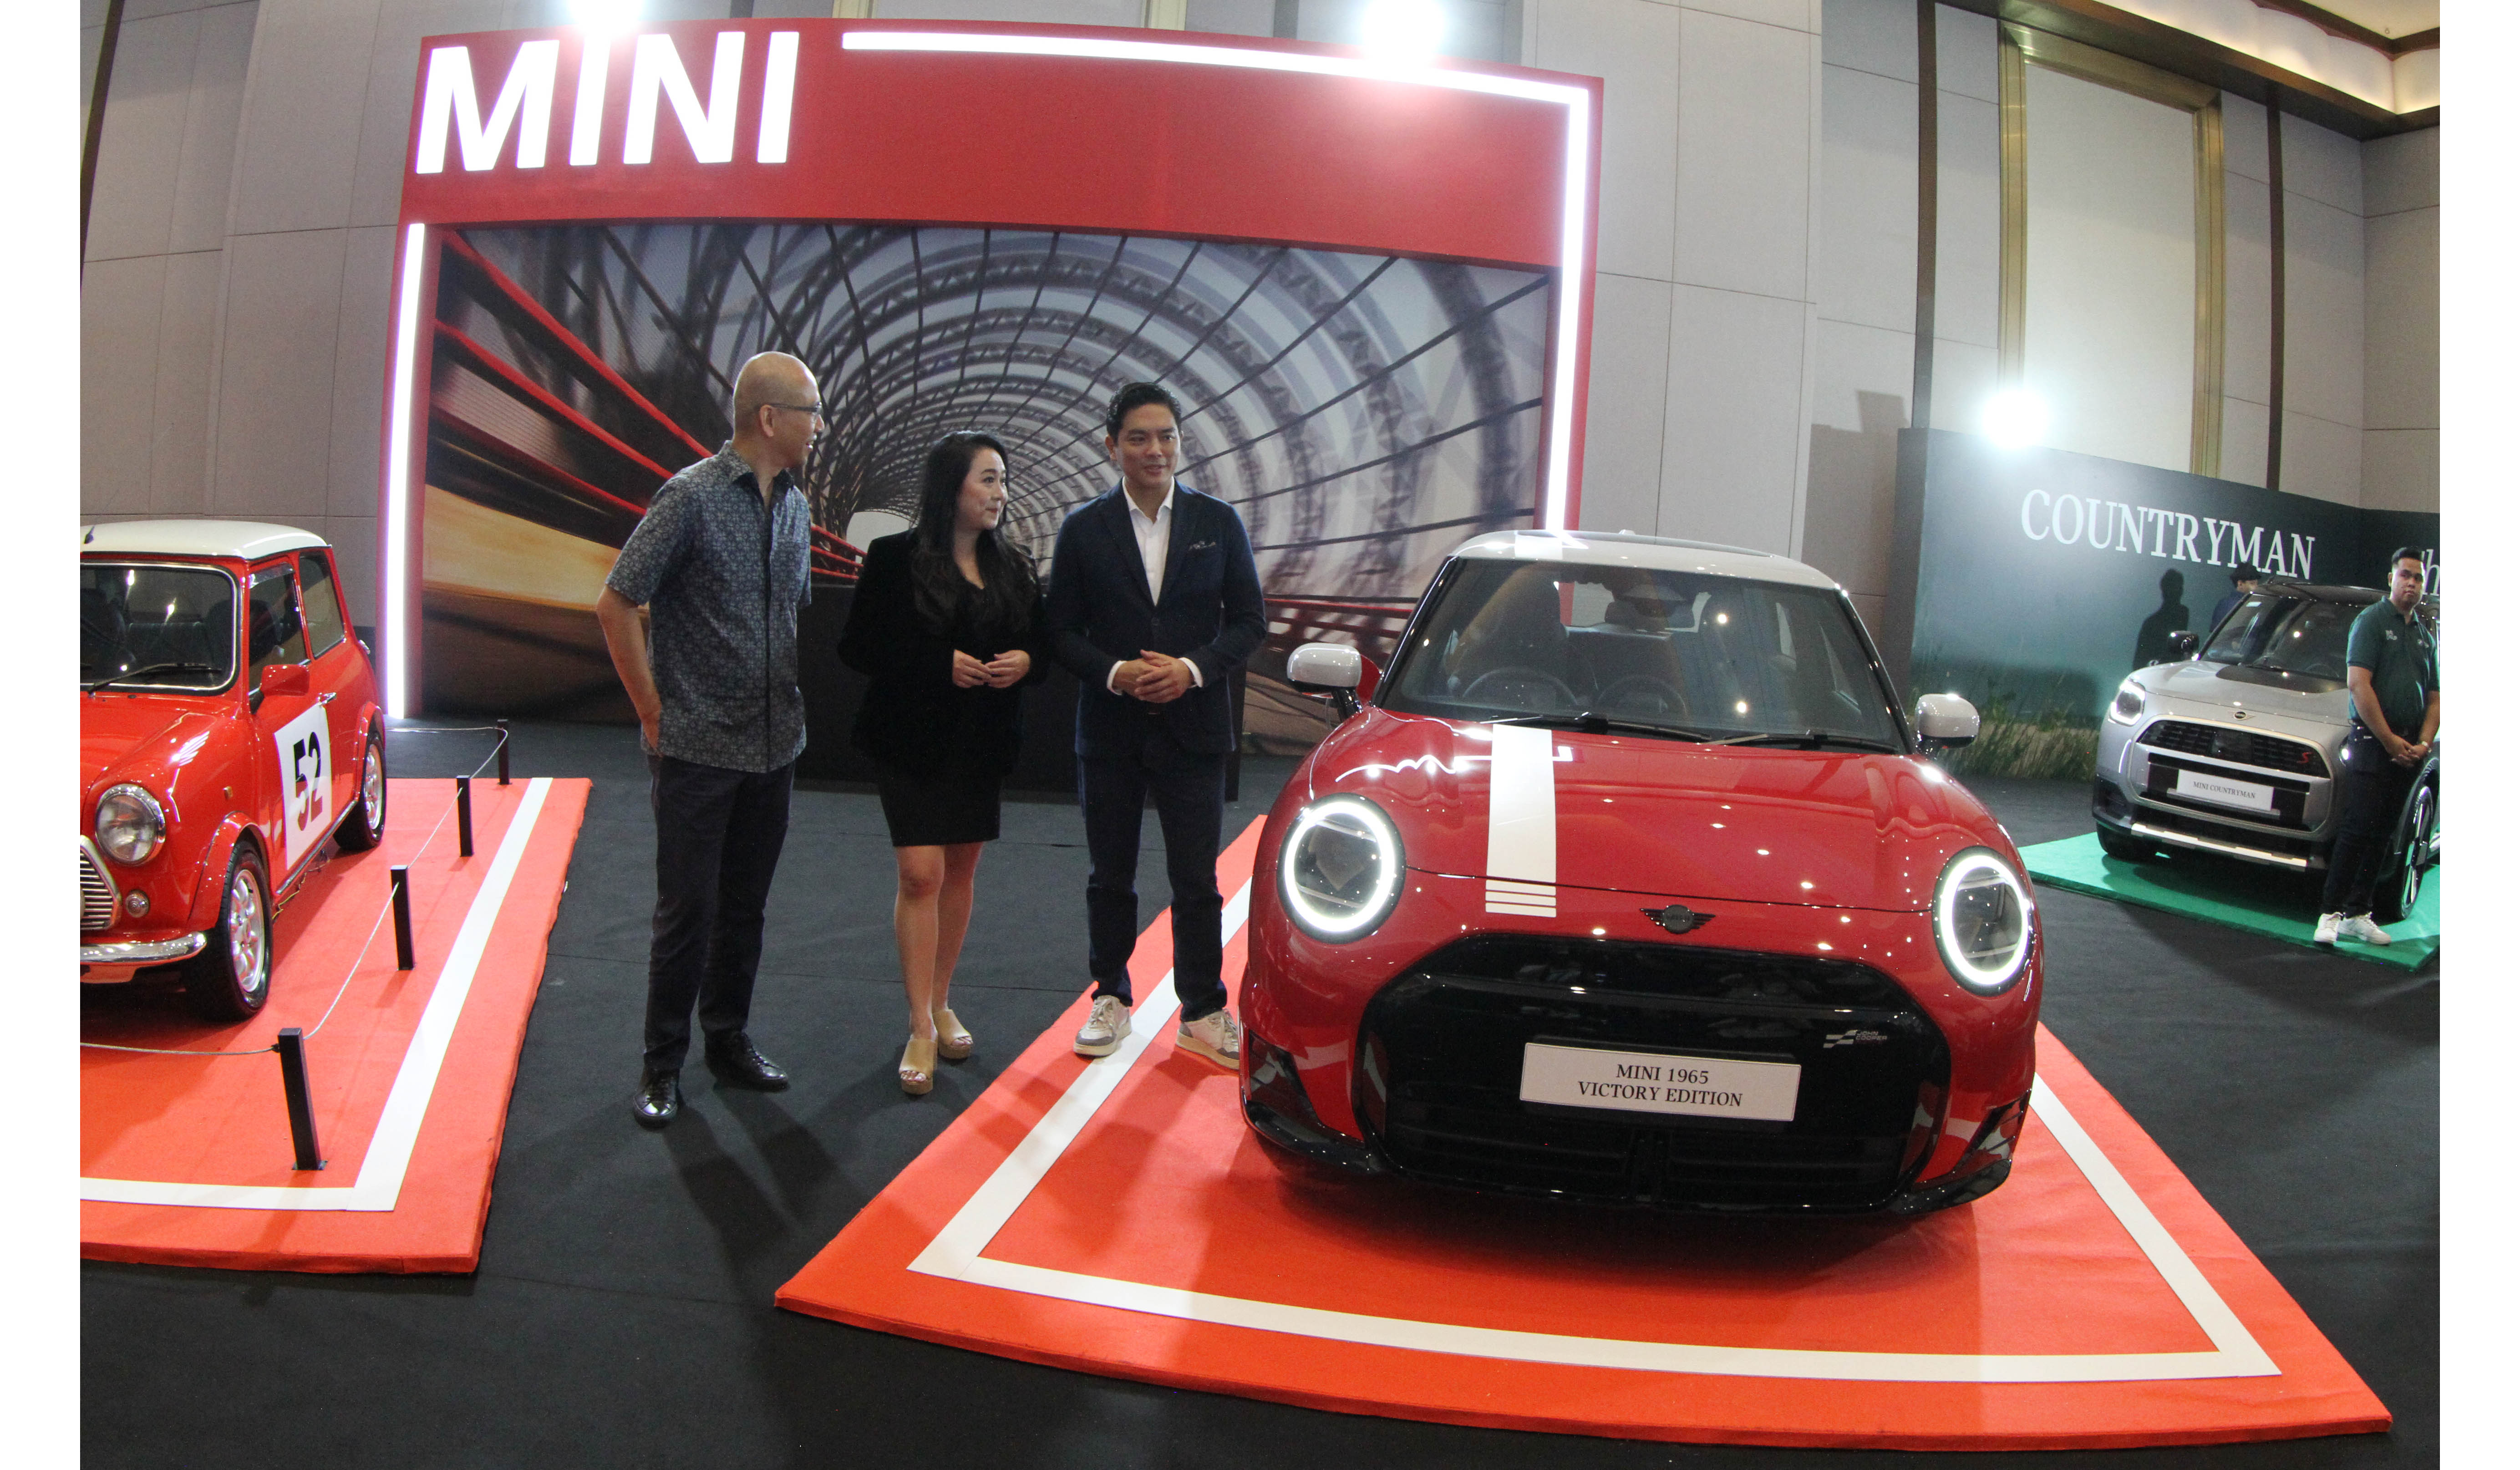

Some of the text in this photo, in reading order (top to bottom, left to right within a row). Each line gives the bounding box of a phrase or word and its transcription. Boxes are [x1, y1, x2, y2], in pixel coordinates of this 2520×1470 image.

[416, 31, 799, 174] MINI
[2022, 489, 2315, 580] COUNTRYMAN
[293, 731, 322, 831] 52
[2193, 781, 2256, 799] MINI COUNTRYMAN
[1577, 1081, 1743, 1107] VICTORY EDITION
[1616, 1063, 1709, 1084] MINI 1965
